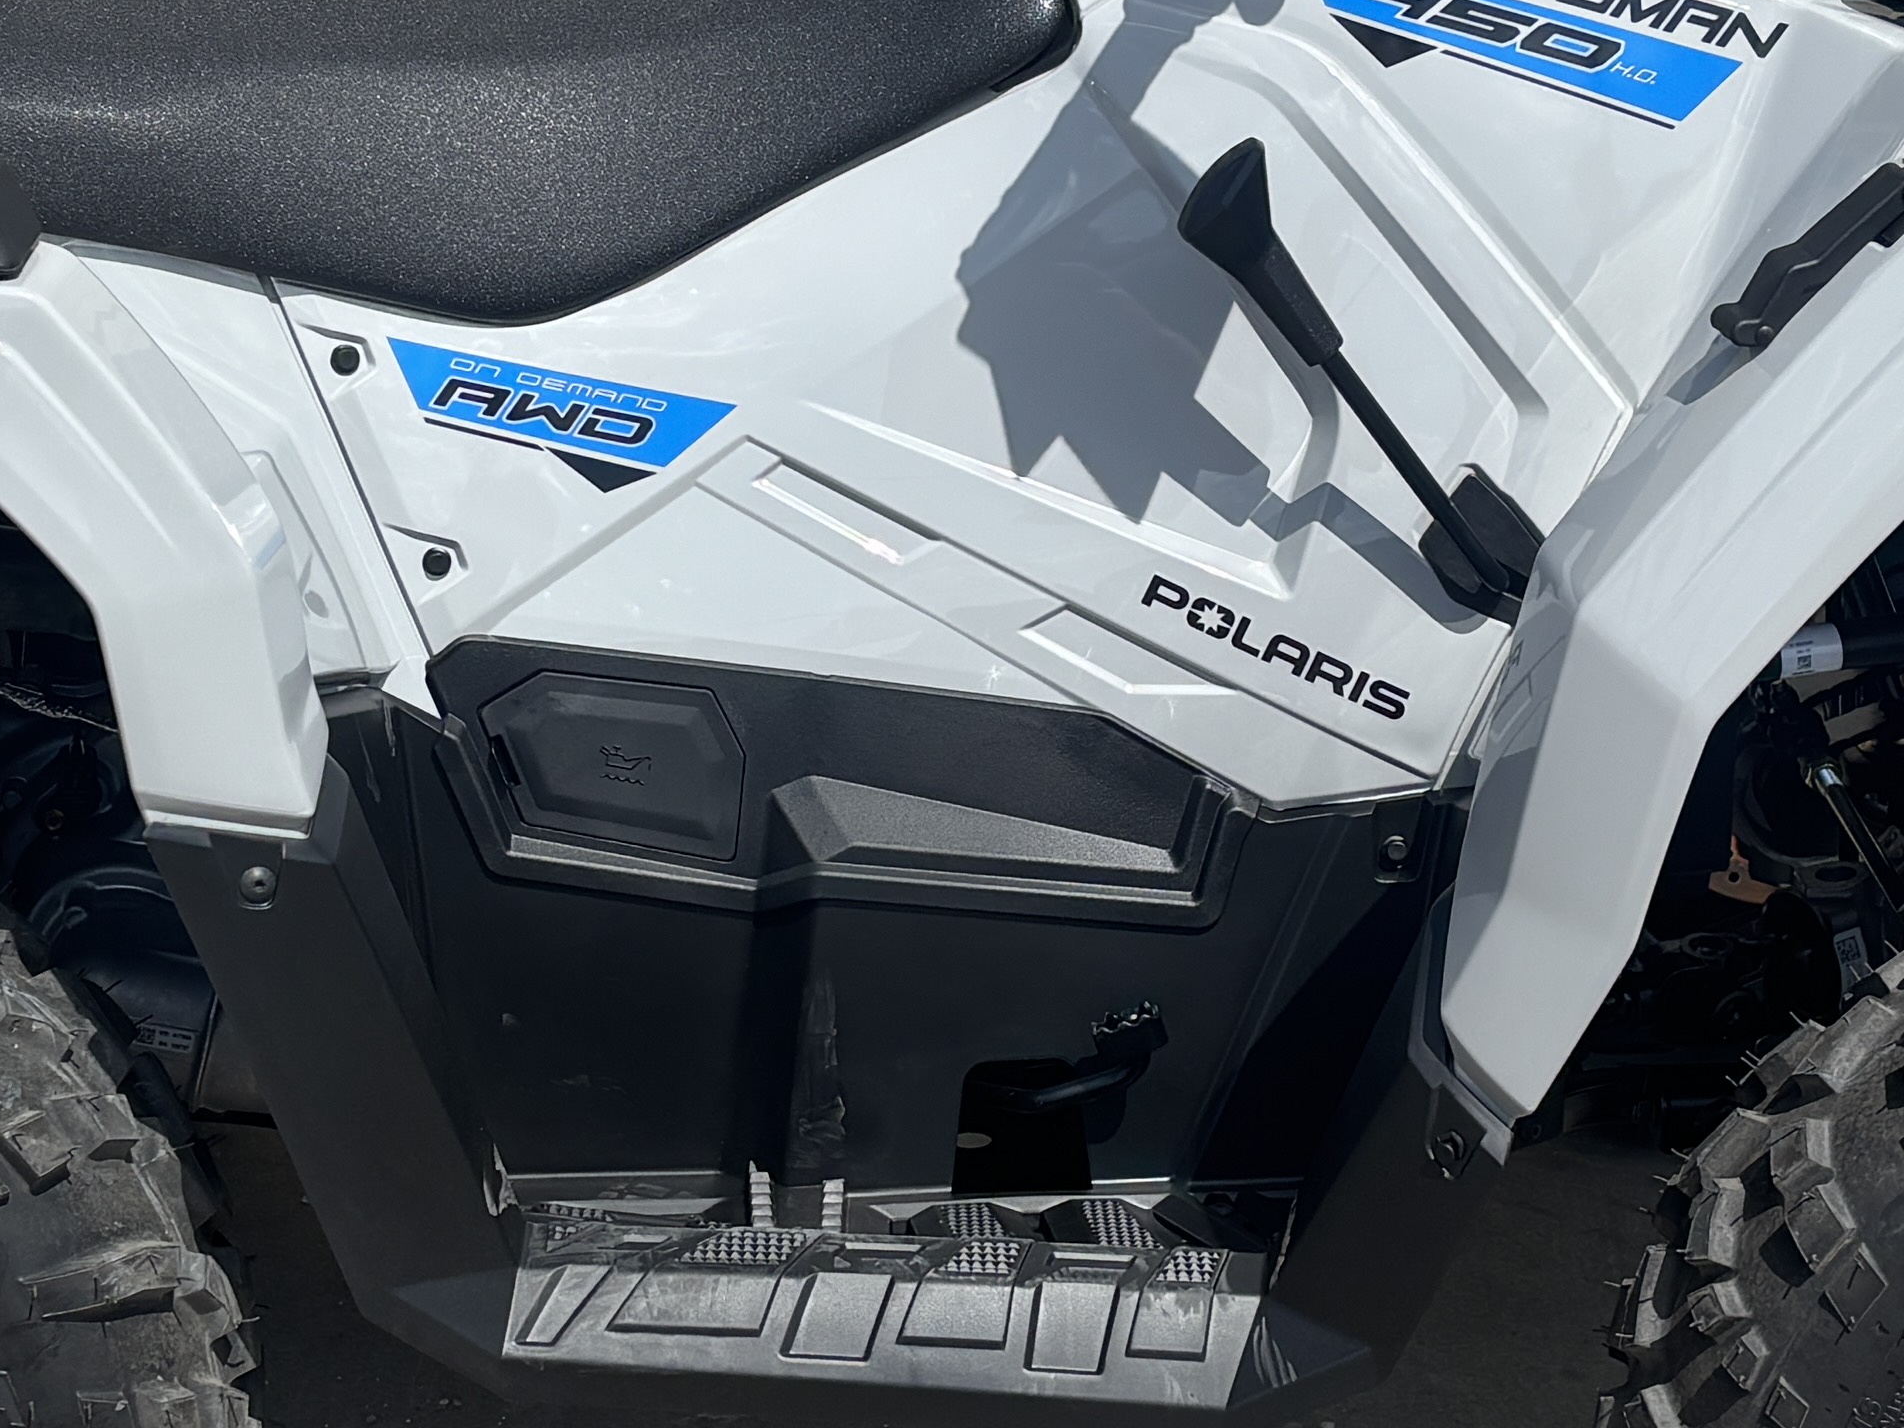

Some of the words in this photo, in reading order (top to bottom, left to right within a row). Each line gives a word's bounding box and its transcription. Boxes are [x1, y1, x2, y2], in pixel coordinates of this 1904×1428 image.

[1608, 59, 1657, 85] H.O.
[429, 376, 656, 447] AWD
[449, 358, 502, 378] ON
[516, 371, 668, 412] DEMAND
[1141, 573, 1411, 720] POLARIS
